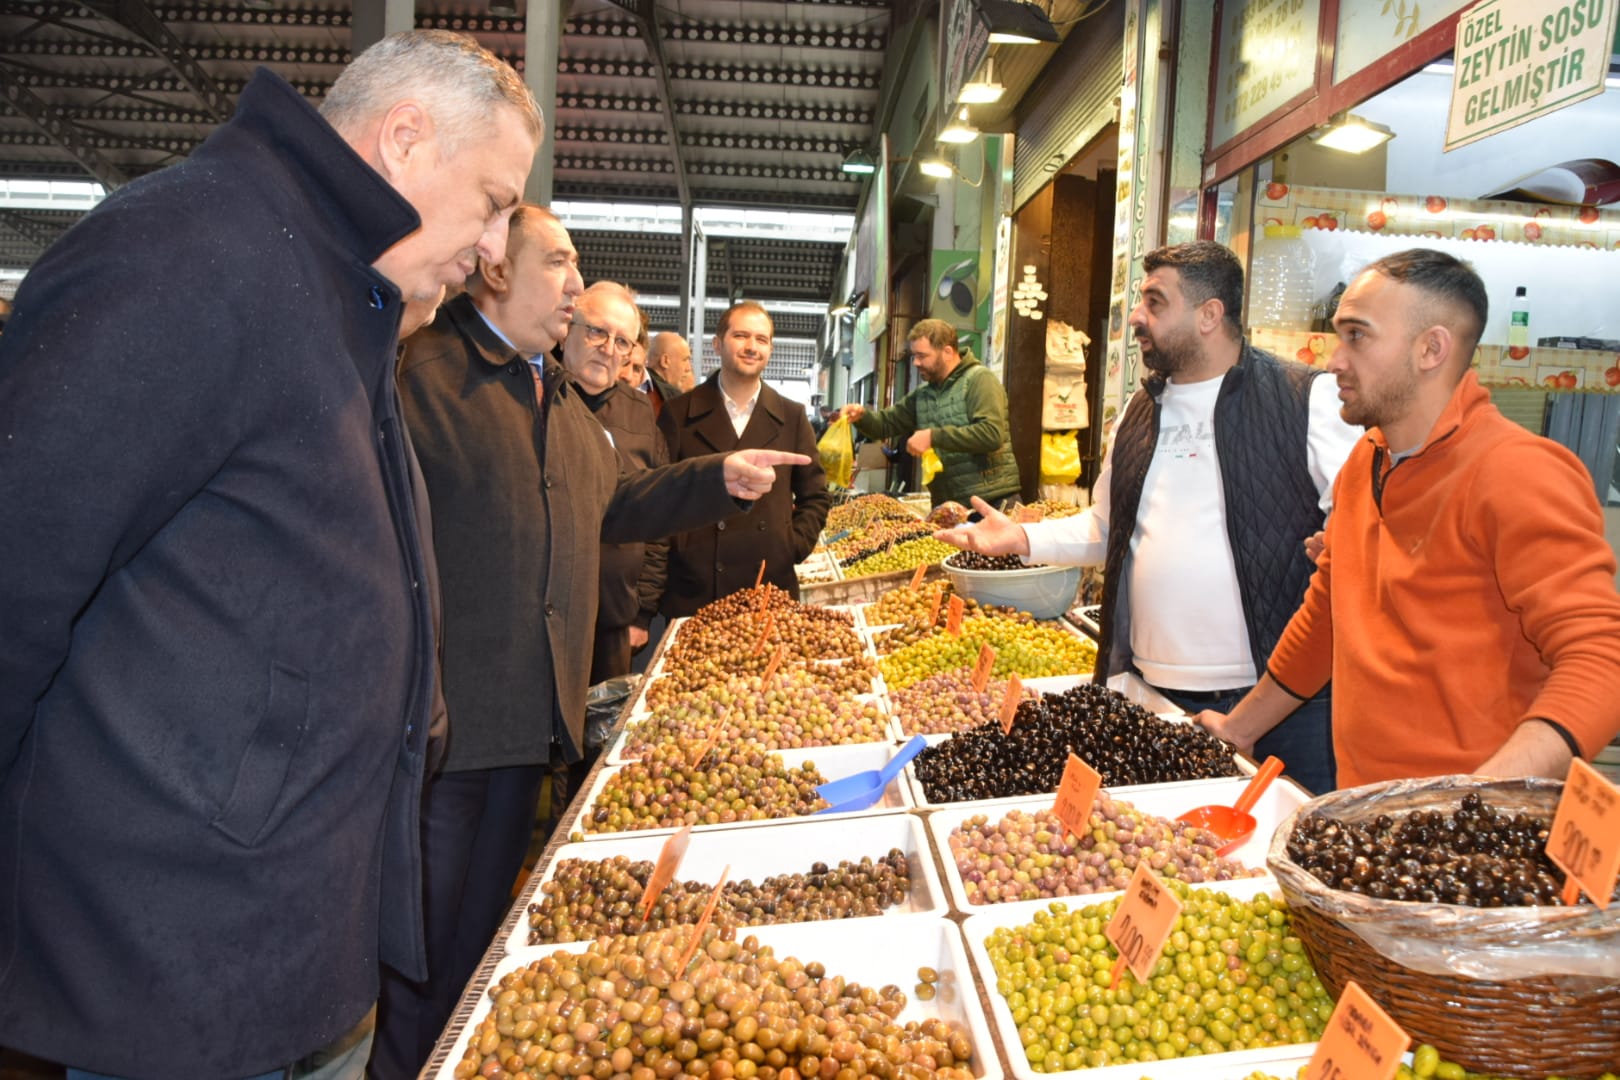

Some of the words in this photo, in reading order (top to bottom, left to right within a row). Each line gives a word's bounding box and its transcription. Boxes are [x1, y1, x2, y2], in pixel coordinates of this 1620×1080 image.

[1459, 25, 1533, 89] ZEYTİN
[1539, 0, 1604, 52] SOSU
[1464, 9, 1503, 48] ÖZEL
[1464, 47, 1585, 126] GELMİŞTİR
